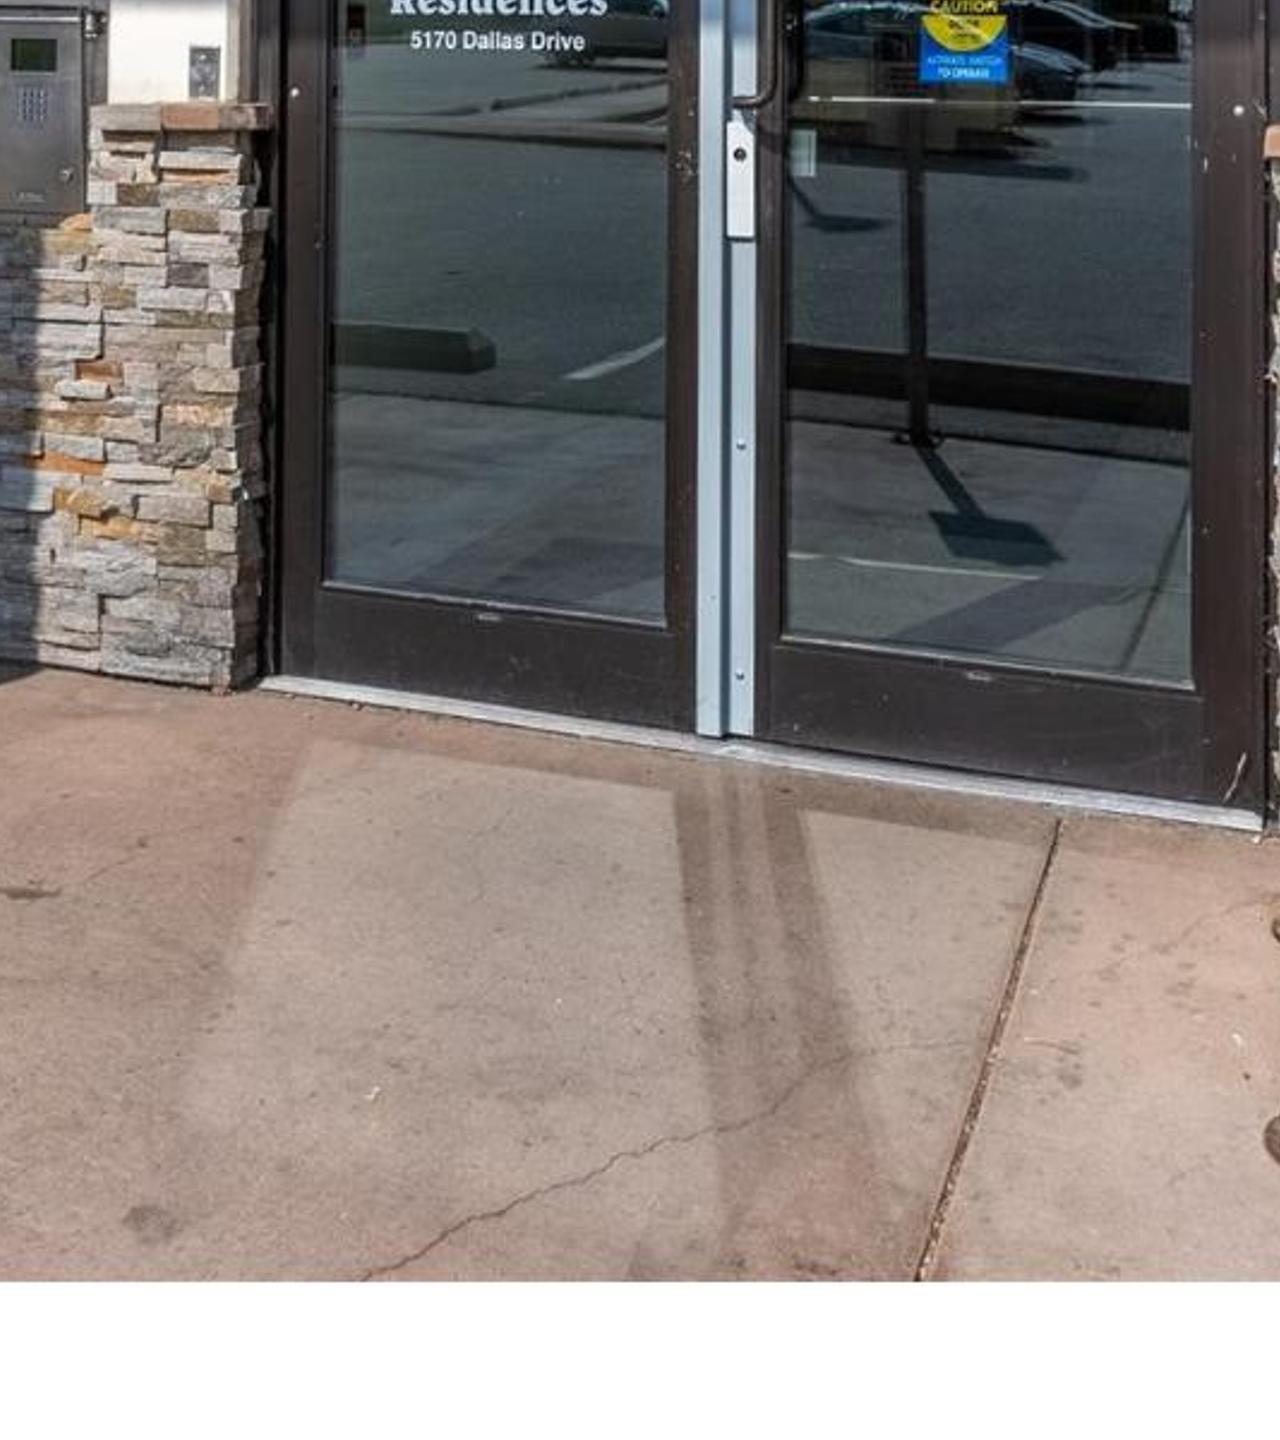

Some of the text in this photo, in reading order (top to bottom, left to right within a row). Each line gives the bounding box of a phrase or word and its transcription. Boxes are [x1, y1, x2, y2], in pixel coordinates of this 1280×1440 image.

[929, 0, 999, 14] CAUTION
[410, 31, 586, 51] 5170 Dallas Drive
